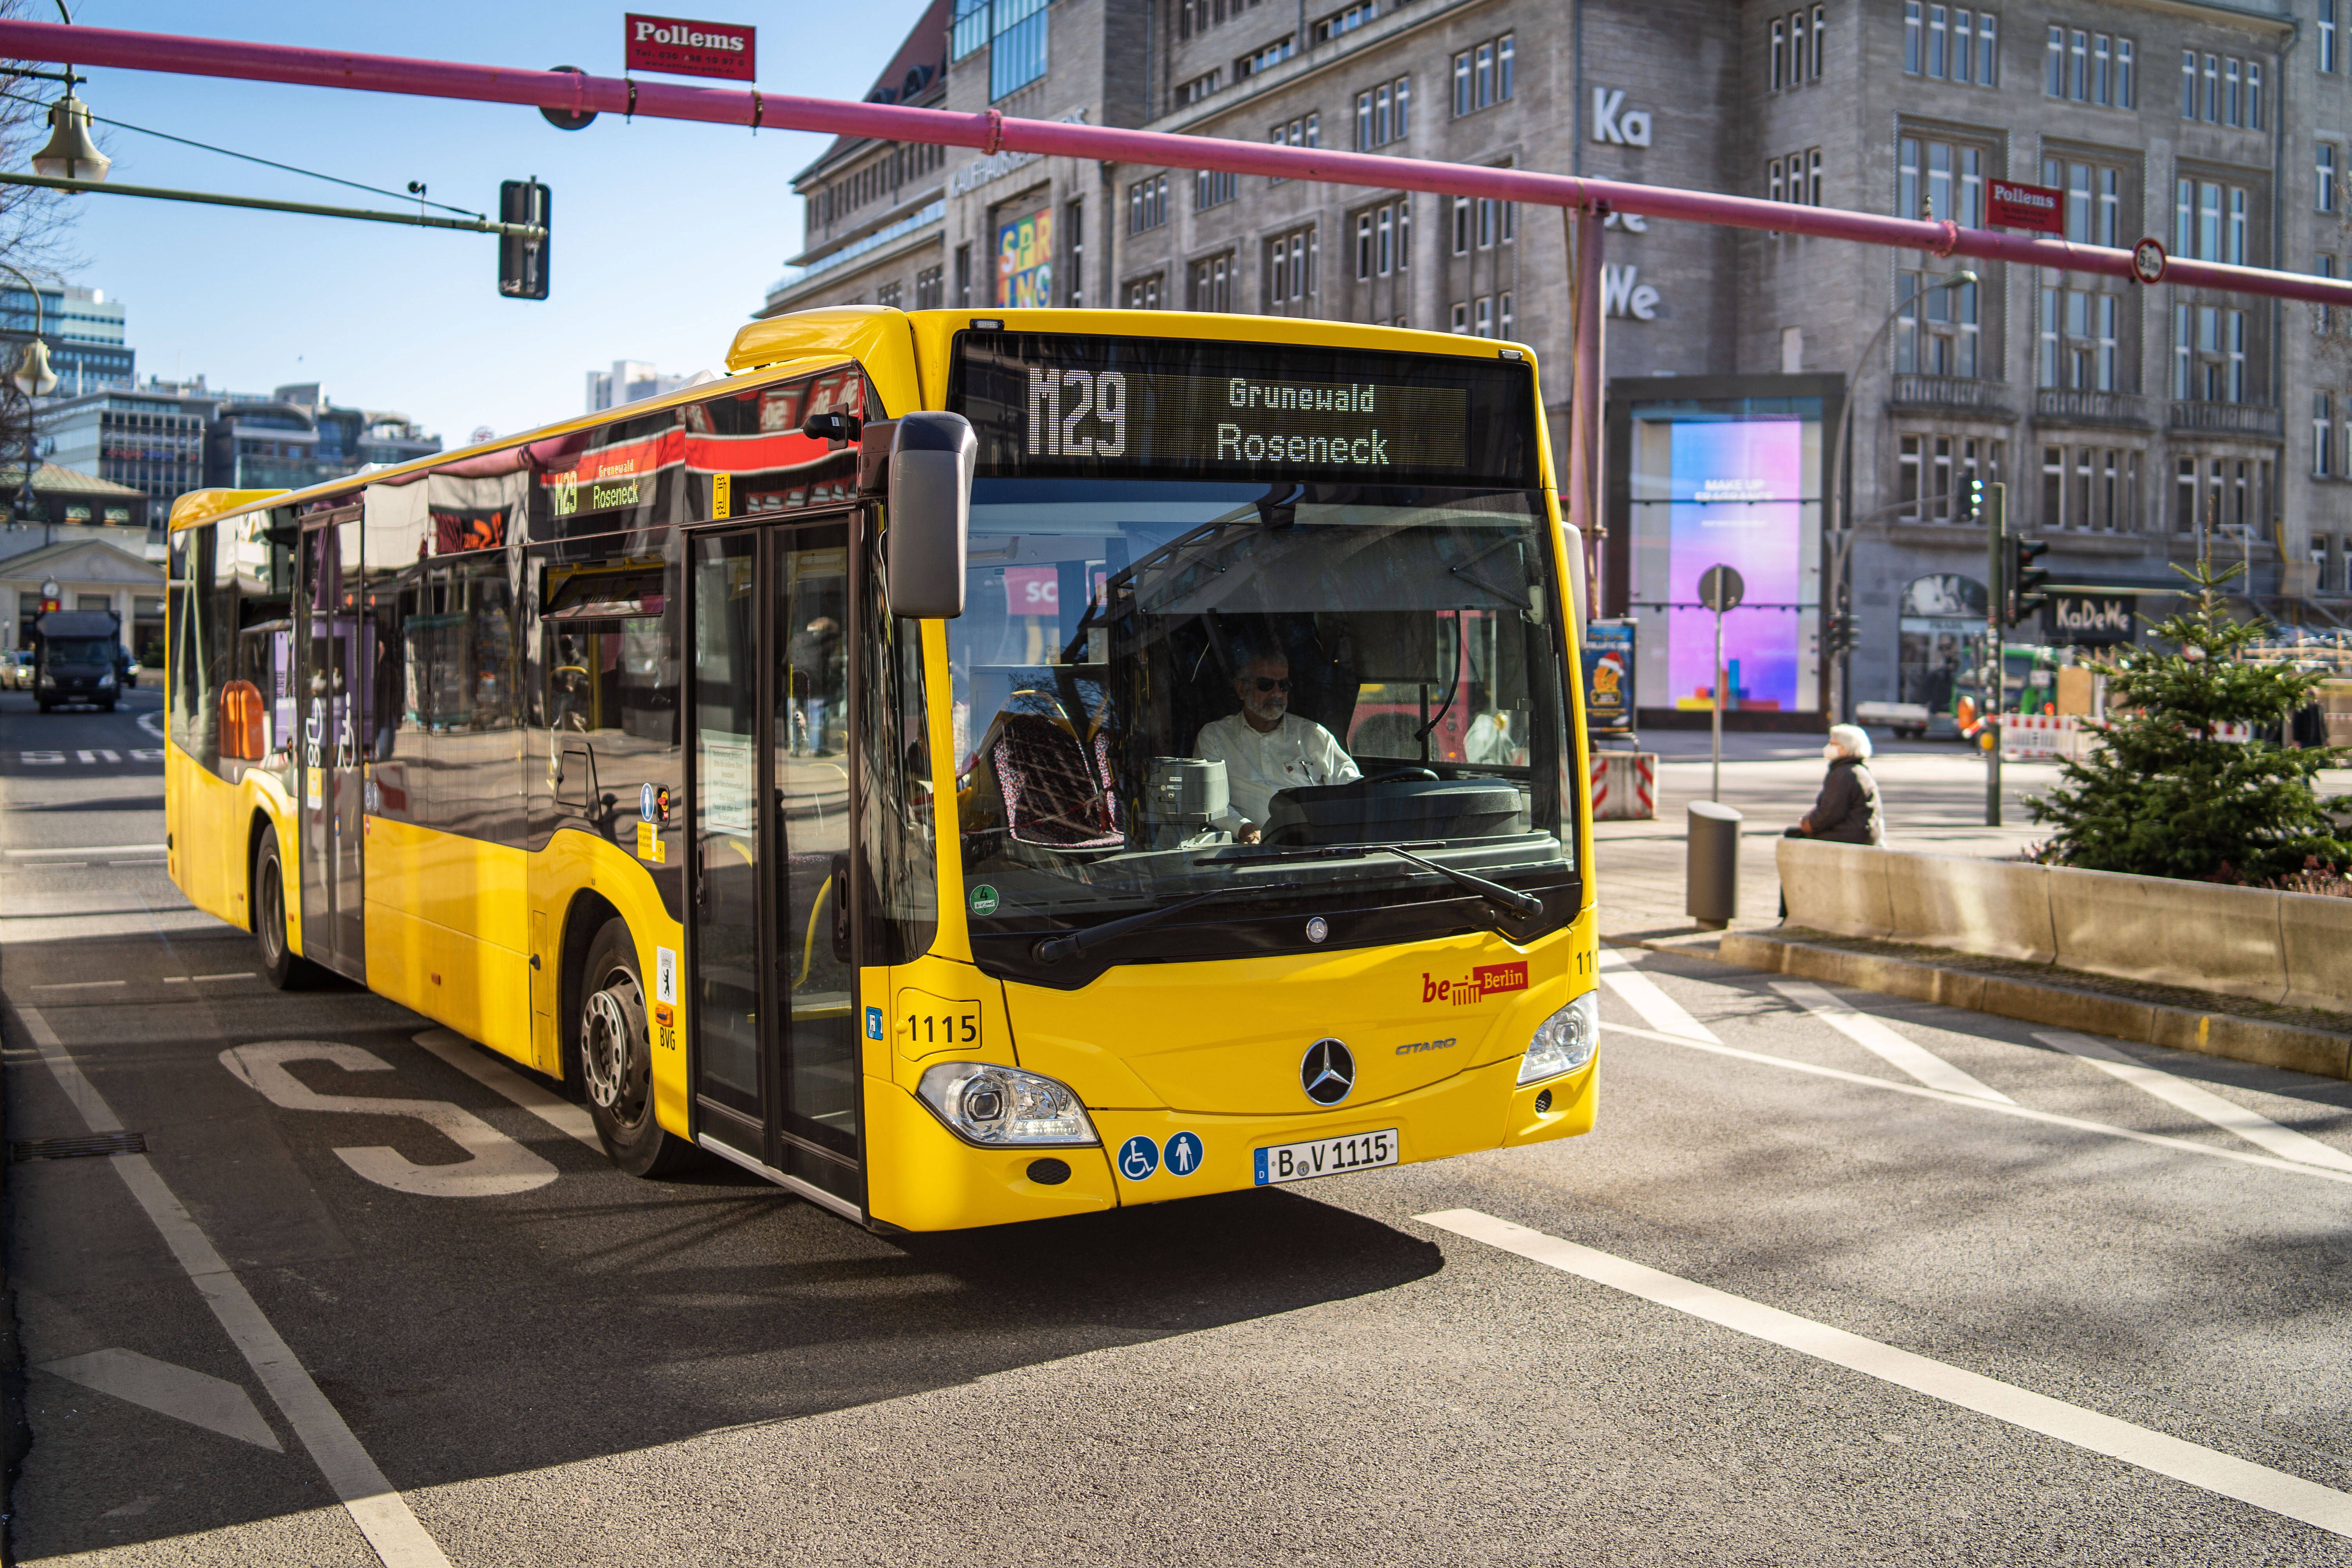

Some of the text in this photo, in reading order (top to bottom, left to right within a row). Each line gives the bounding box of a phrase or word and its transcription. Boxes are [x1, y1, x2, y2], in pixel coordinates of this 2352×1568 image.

[635, 21, 744, 51] Pollems
[1592, 87, 1651, 146] Ka
[1994, 185, 2056, 208] Pollems
[1027, 368, 1374, 457] M29 Grunewald
[1218, 423, 1390, 465] Roseneck
[555, 459, 633, 516] M29 Grunewald
[593, 479, 639, 510] Roseneck
[2057, 598, 2130, 632] KaDeWe
[980, 887, 988, 900] 4
[1423, 969, 1524, 1003] be Berlin
[660, 1026, 675, 1051] BVG
[908, 1014, 976, 1043] 1115
[1396, 1037, 1457, 1055] CITARO
[1259, 1134, 1387, 1179] D B V 1115
